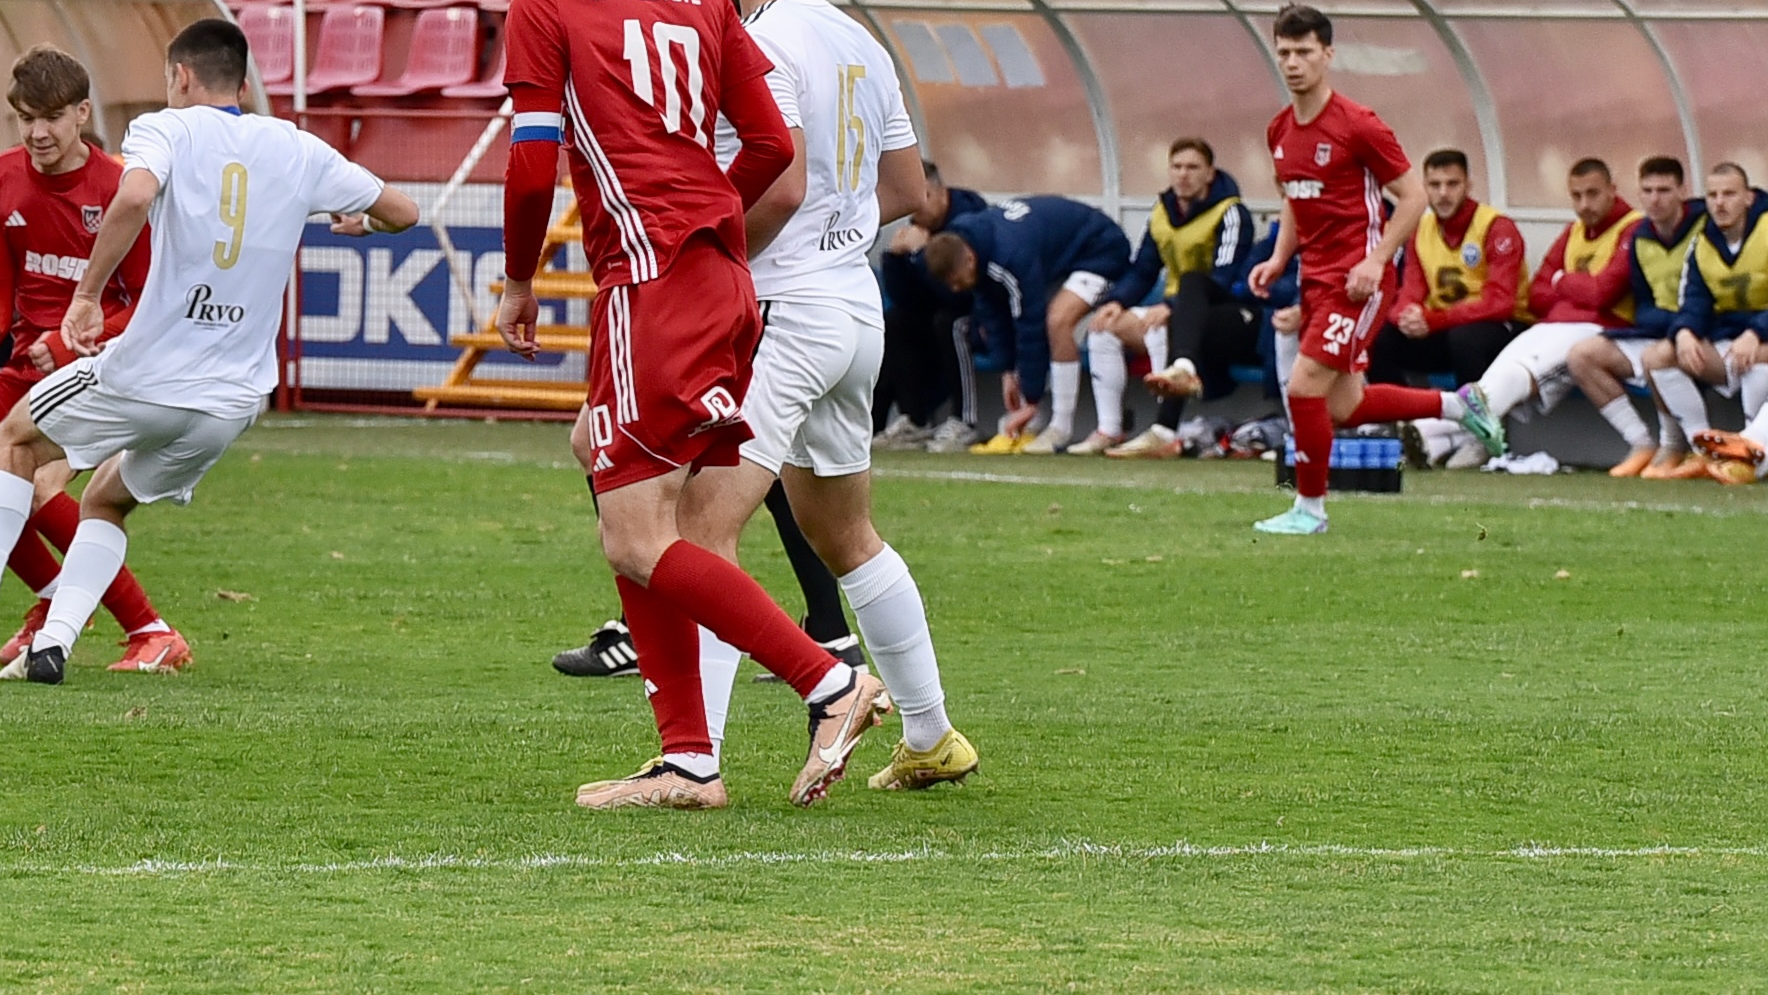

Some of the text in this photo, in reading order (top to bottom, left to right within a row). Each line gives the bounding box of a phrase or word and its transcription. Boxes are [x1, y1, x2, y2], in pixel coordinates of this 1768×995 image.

[623, 18, 708, 150] 10
[836, 62, 867, 193] 15
[212, 162, 248, 271] 9
[1323, 313, 1354, 345] 23
[1436, 266, 1470, 303] 5
